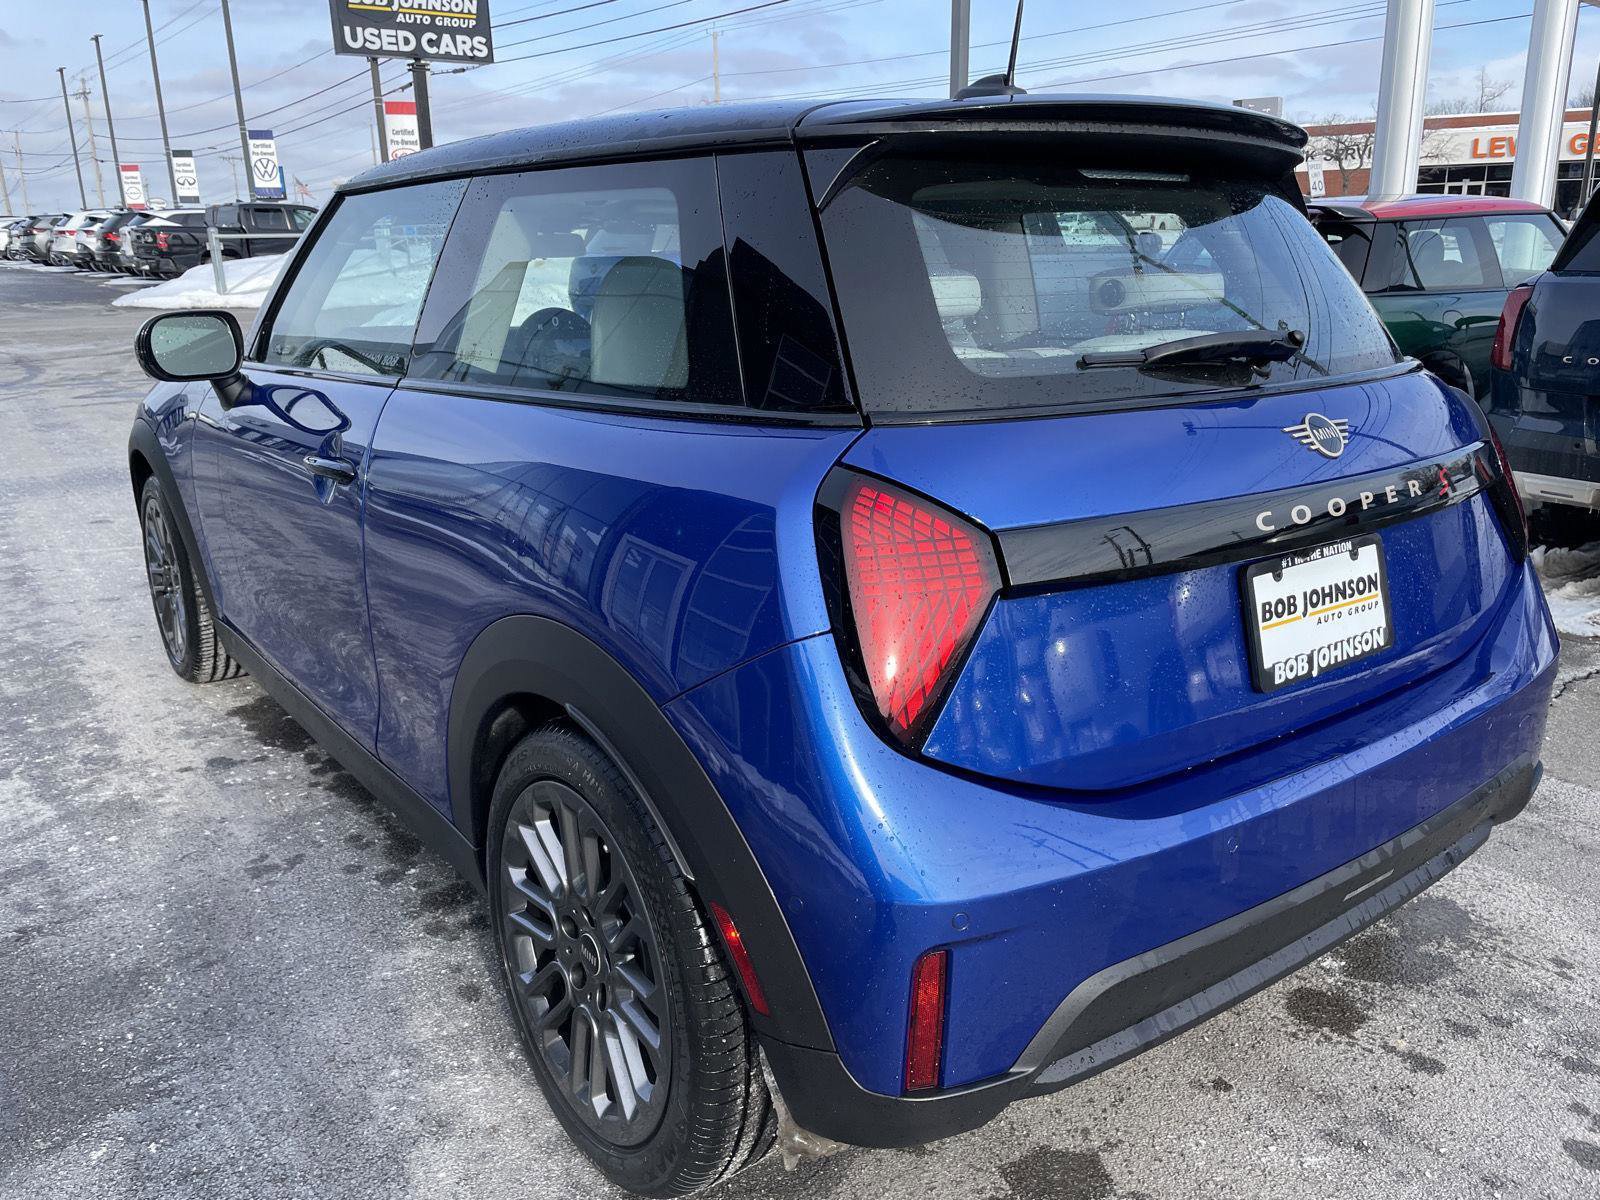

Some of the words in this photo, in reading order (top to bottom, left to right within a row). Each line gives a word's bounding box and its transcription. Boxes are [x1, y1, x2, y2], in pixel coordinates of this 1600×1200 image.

[396, 13, 431, 24] AUTO
[435, 16, 477, 29] GROUP
[343, 25, 417, 52] USED
[420, 32, 489, 58] CARS
[1312, 180, 1324, 191] 40
[1313, 427, 1339, 440] MINI
[1255, 480, 1422, 531] COOPER
[1438, 467, 1450, 496] S
[1281, 557, 1292, 568] #1
[1322, 540, 1353, 557] NATION
[1261, 594, 1298, 623] BOB
[1302, 572, 1379, 618] JOHNSON
[1316, 611, 1343, 625] AUTO
[1347, 601, 1379, 615] GROUP
[1273, 653, 1309, 685] BOB
[1311, 626, 1385, 677] JOHNSON
